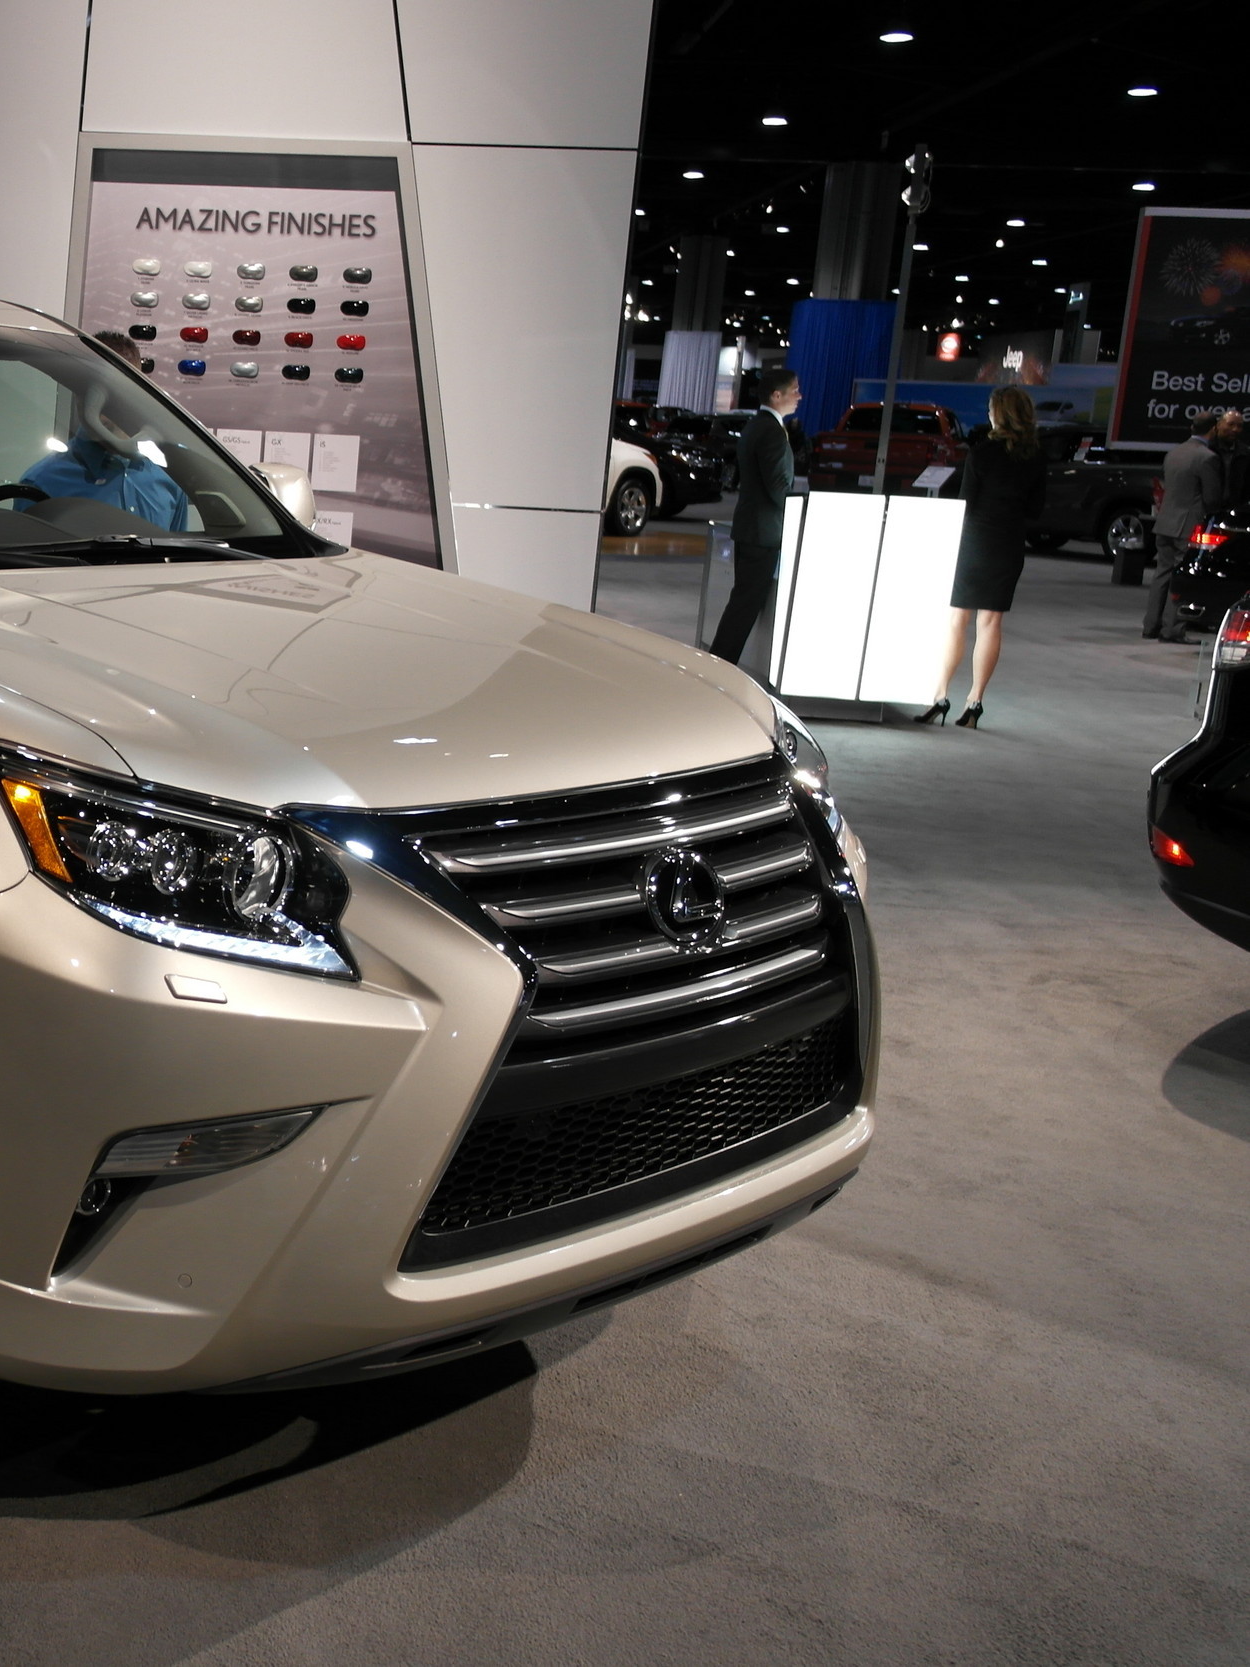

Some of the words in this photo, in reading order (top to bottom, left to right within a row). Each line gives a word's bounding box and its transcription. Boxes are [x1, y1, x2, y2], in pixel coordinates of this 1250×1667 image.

[136, 207, 261, 234] AMAZING
[268, 211, 376, 238] FINISHES
[1003, 345, 1023, 372] Jeep
[1151, 370, 1205, 392] Best
[1147, 399, 1179, 419] for
[271, 438, 282, 446] GX
